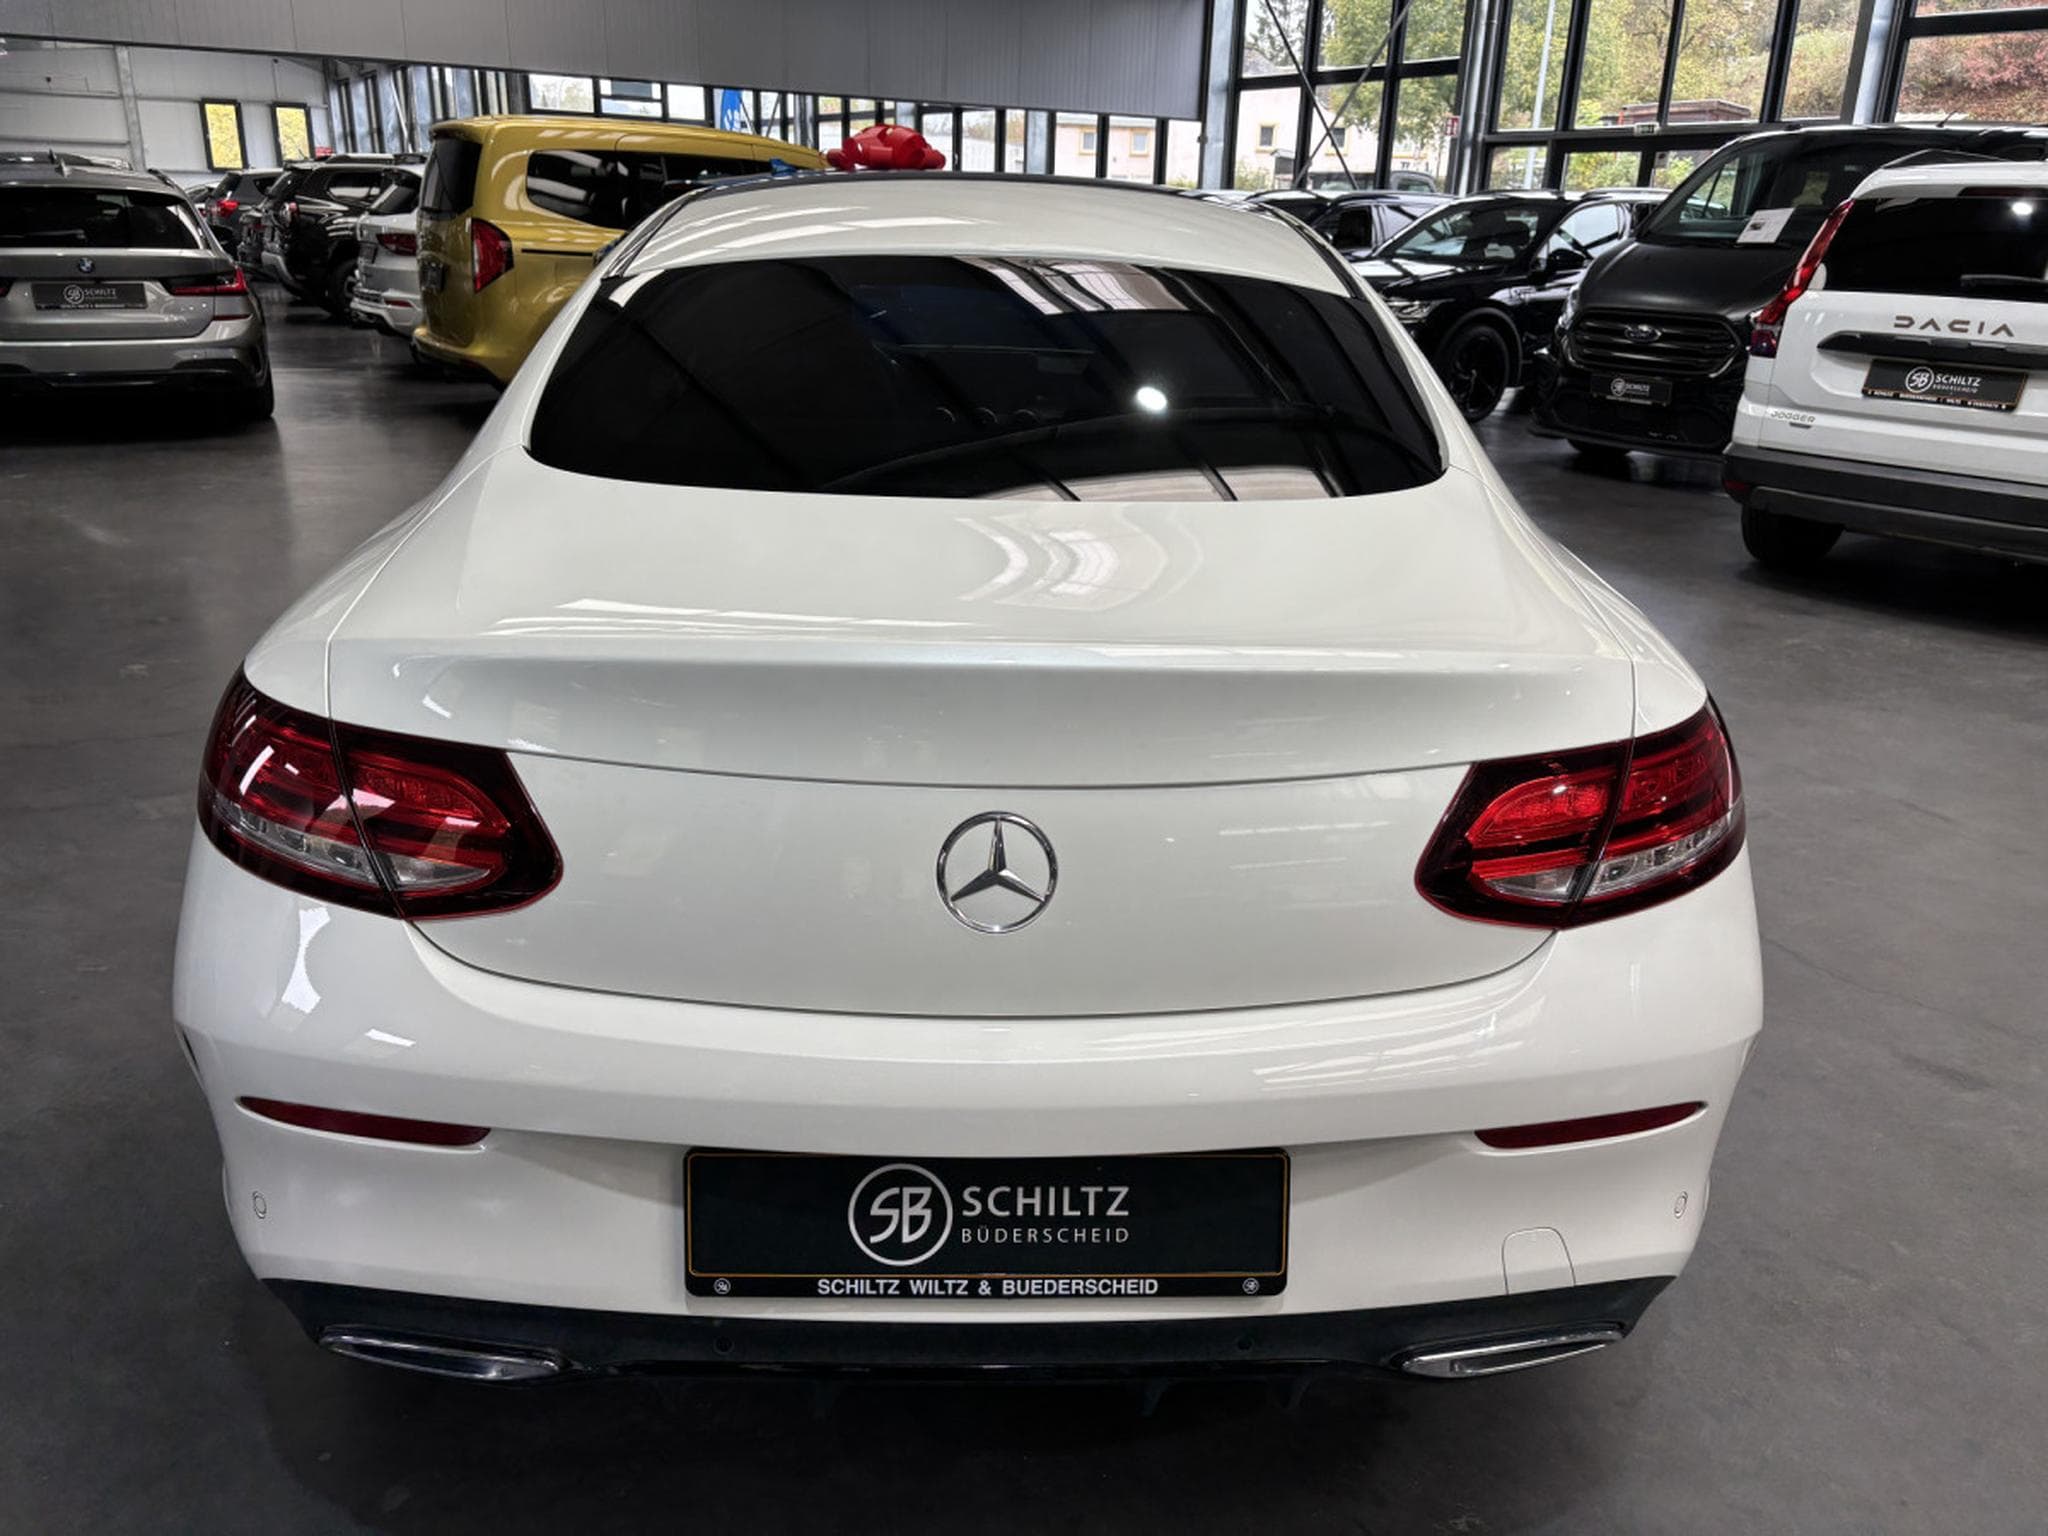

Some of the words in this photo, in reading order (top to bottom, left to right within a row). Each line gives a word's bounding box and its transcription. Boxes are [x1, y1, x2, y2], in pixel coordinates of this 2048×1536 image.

[1894, 315, 2014, 337] DACIA
[1935, 373, 1981, 387] SCHILTZ
[961, 1186, 1129, 1217] SCHILTZ
[869, 1186, 932, 1244] SB
[961, 1225, 1129, 1243] BÜDERSCHEID
[817, 1279, 900, 1295] SCHILTZ
[909, 1279, 969, 1295] WILTZ
[978, 1280, 992, 1295] &
[1002, 1279, 1158, 1295] BUEDERSCHEID
